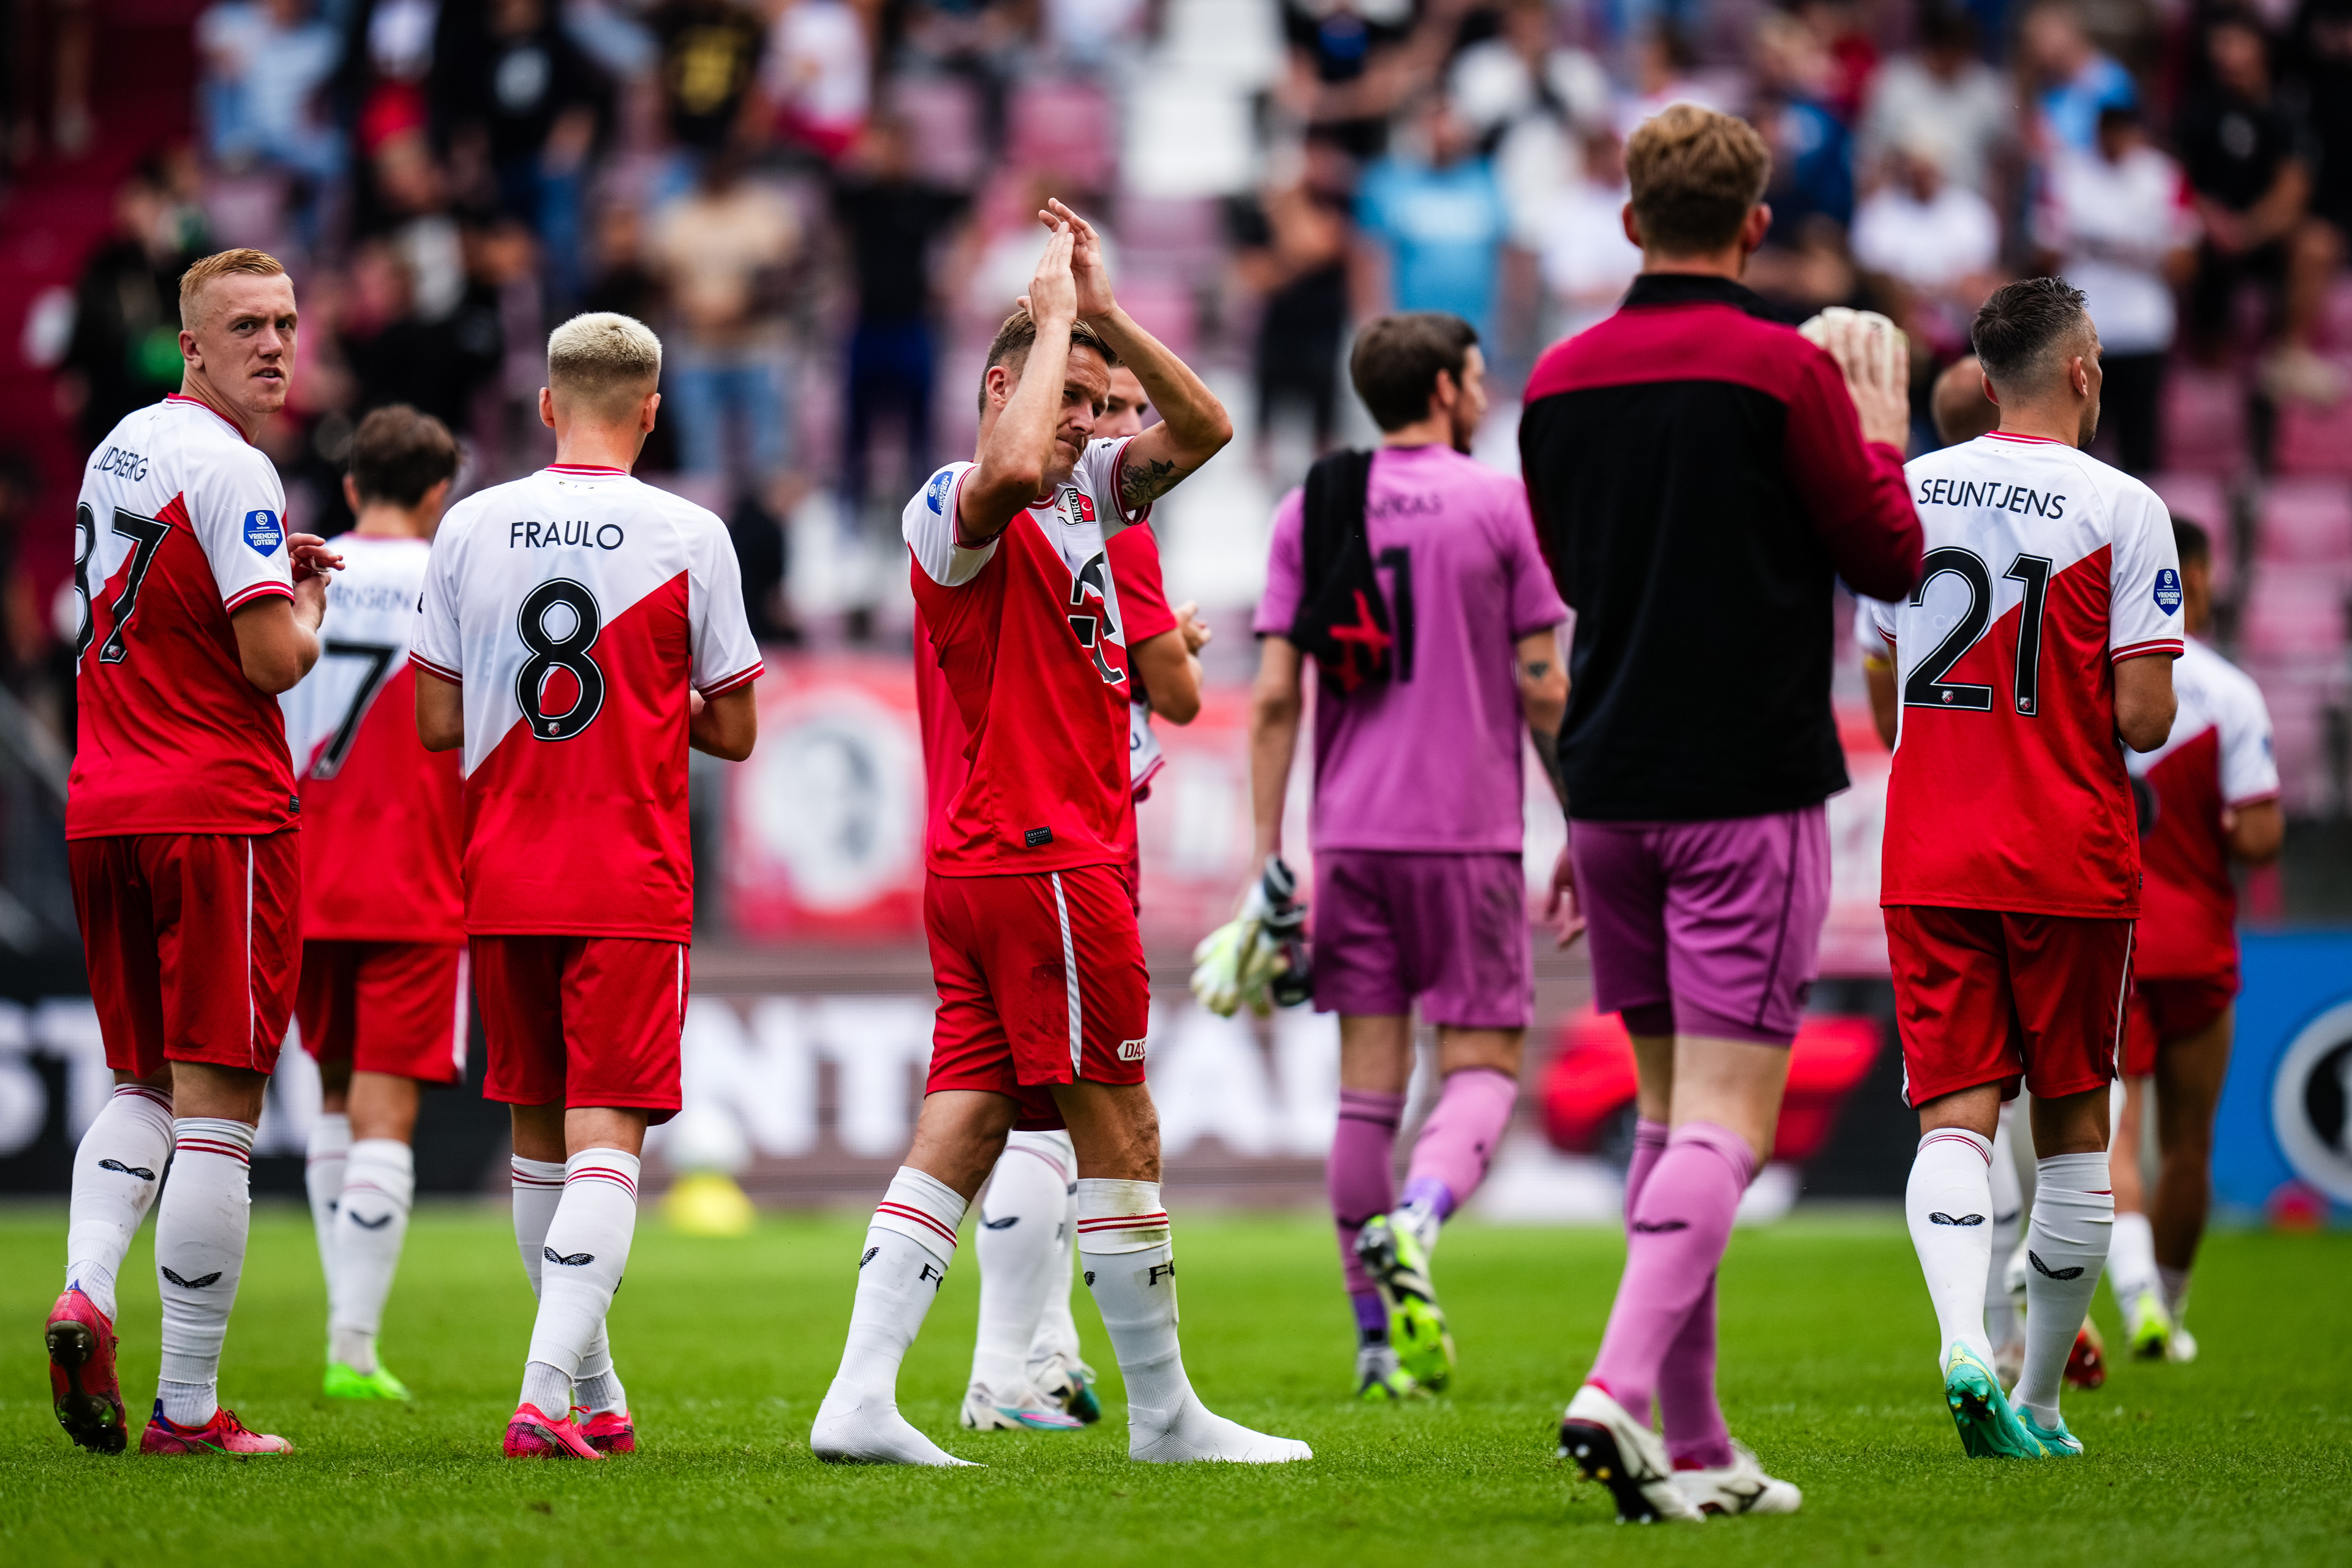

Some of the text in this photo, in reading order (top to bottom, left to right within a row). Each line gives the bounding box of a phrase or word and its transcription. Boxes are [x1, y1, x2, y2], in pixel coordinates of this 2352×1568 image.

[510, 521, 624, 550] FRAULO
[1068, 489, 1084, 524] UTRECHT
[1918, 479, 2067, 519] SEUNTJENS
[516, 578, 606, 742] 8
[1378, 544, 1417, 683] 1
[1904, 546, 2053, 718] 21
[310, 638, 400, 780] 7
